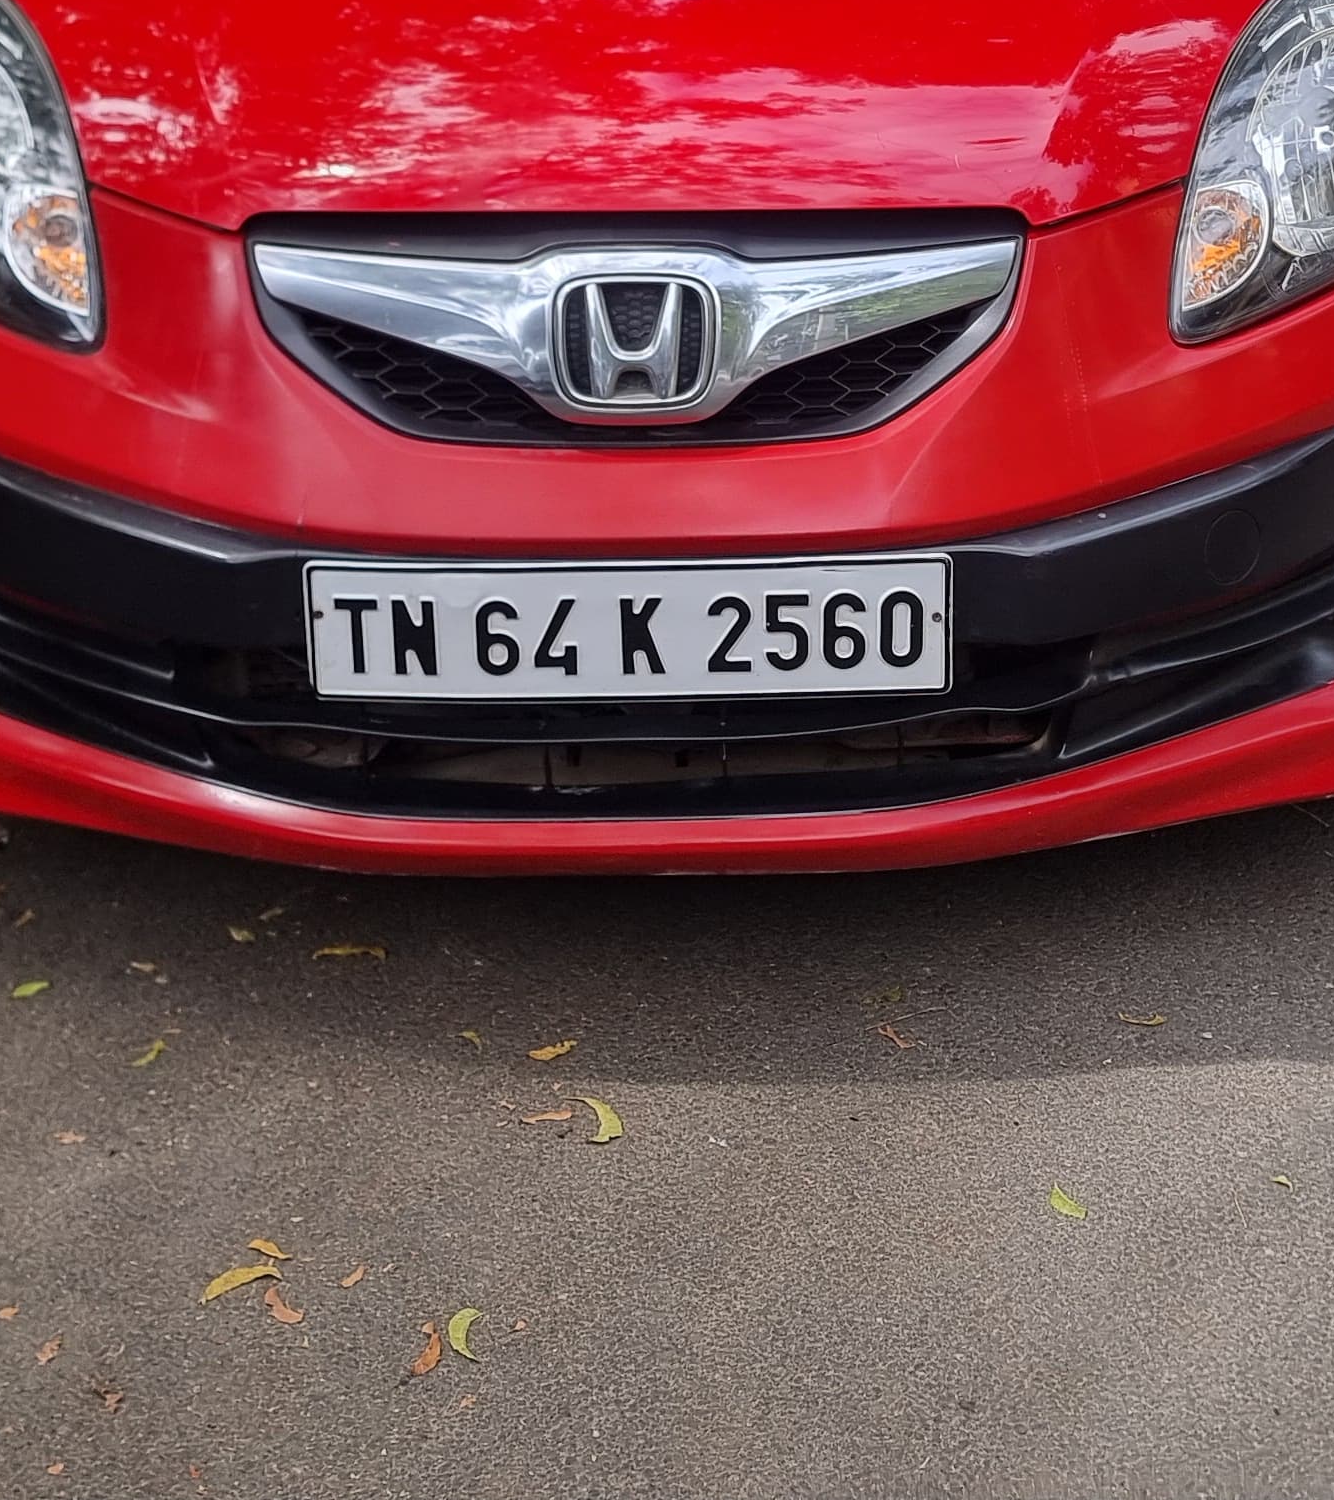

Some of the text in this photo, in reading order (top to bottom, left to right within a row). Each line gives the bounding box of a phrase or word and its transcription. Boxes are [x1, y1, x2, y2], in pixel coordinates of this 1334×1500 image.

[333, 591, 925, 676] TN 64 K 2560
